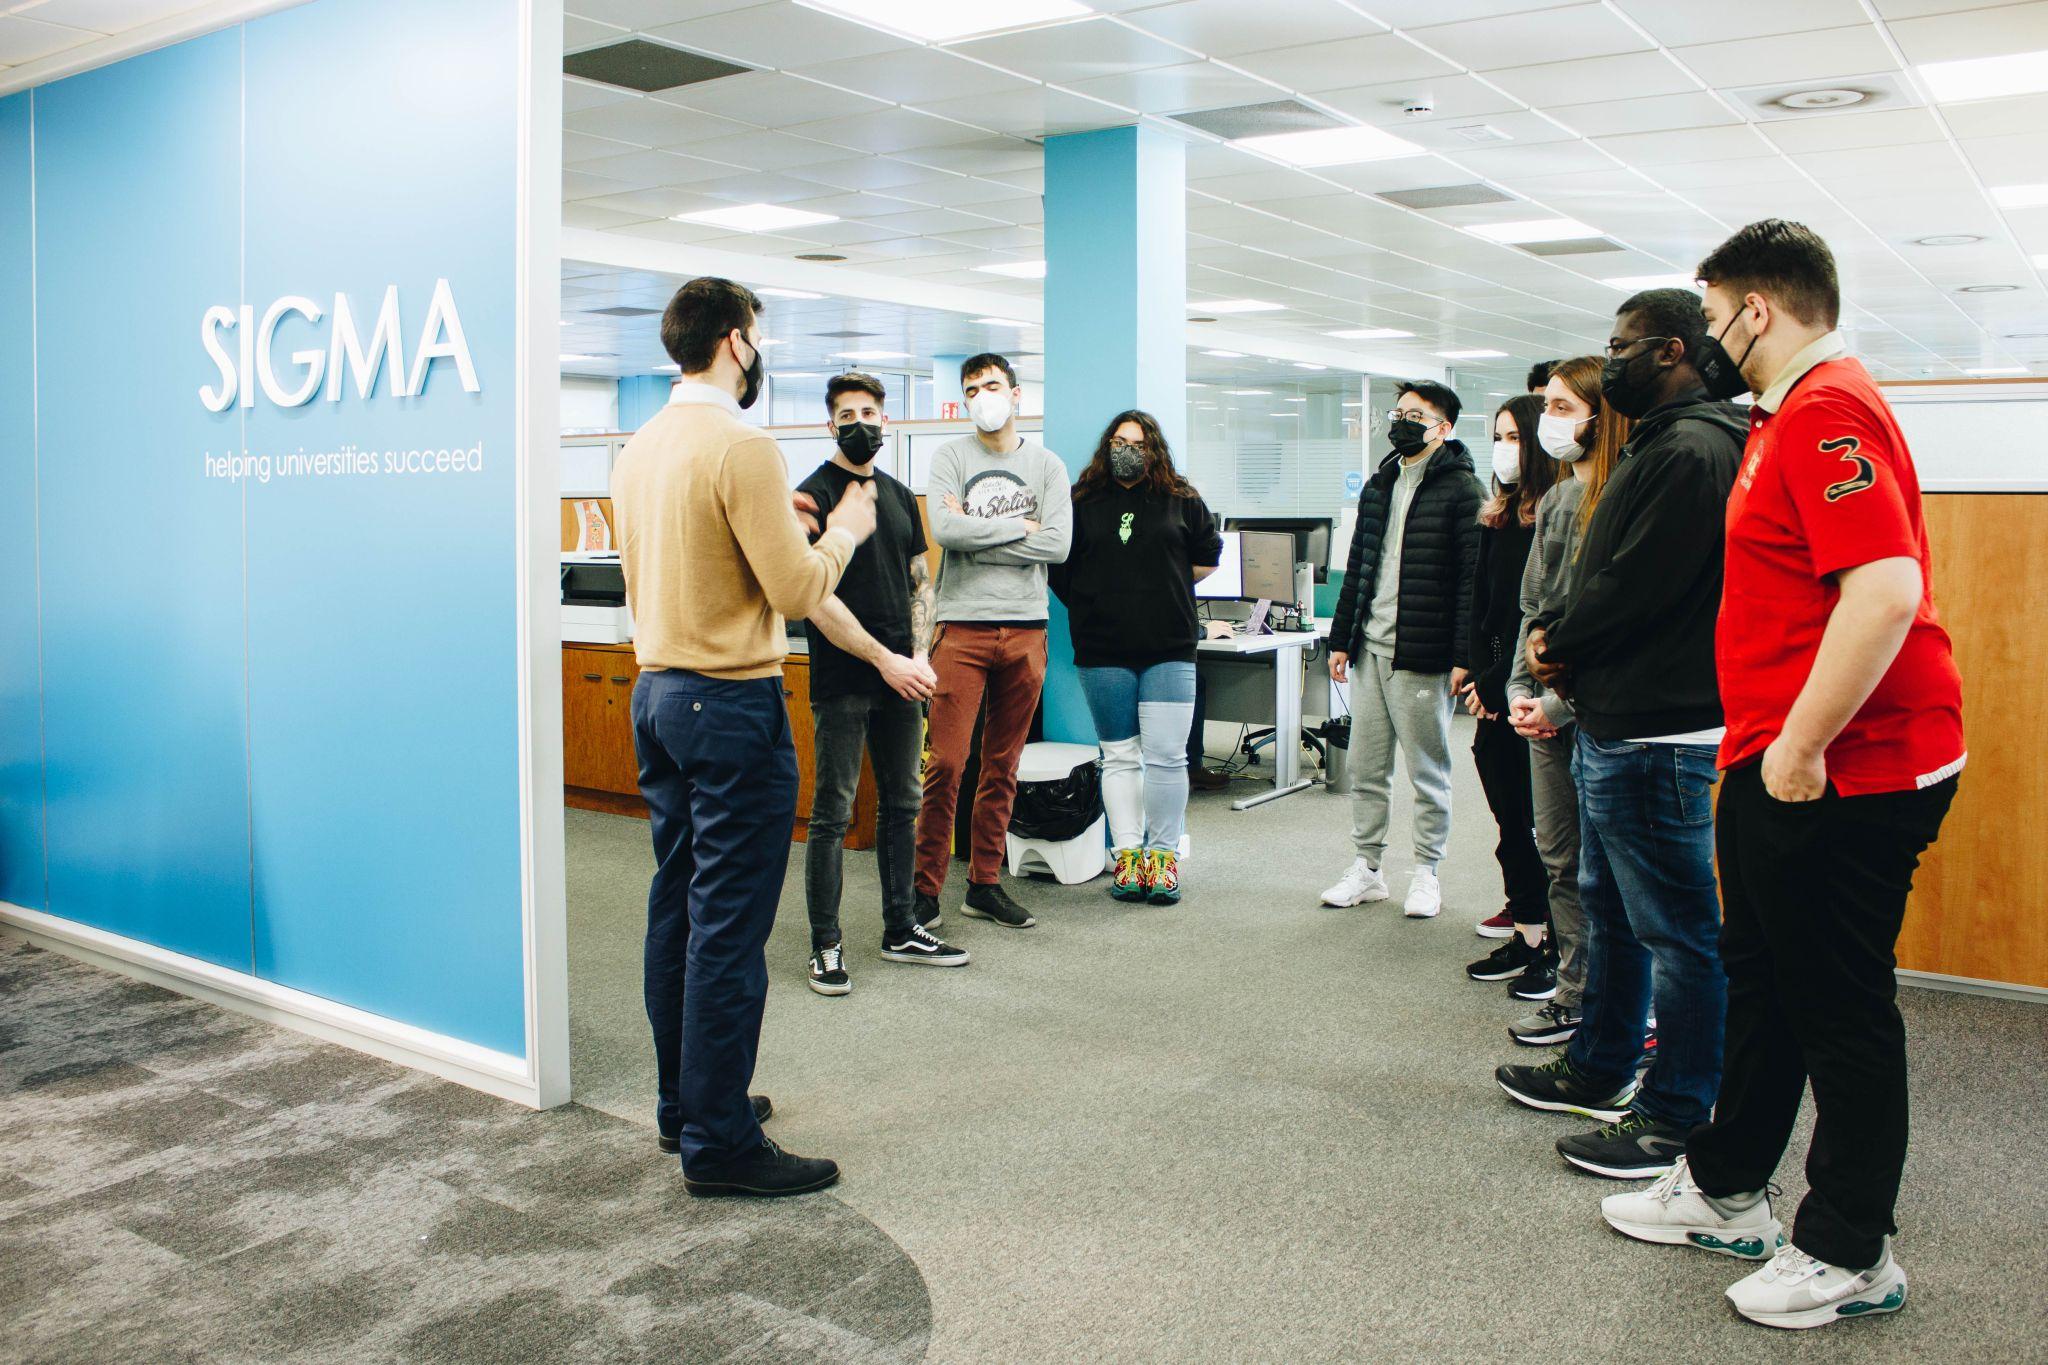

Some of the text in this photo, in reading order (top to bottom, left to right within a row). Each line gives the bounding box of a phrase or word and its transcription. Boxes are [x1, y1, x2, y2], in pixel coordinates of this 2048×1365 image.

[198, 278, 481, 412] SIGMA
[205, 441, 482, 483] helping universities succeed
[1818, 436, 1876, 502] 3
[985, 491, 1038, 518] Station
